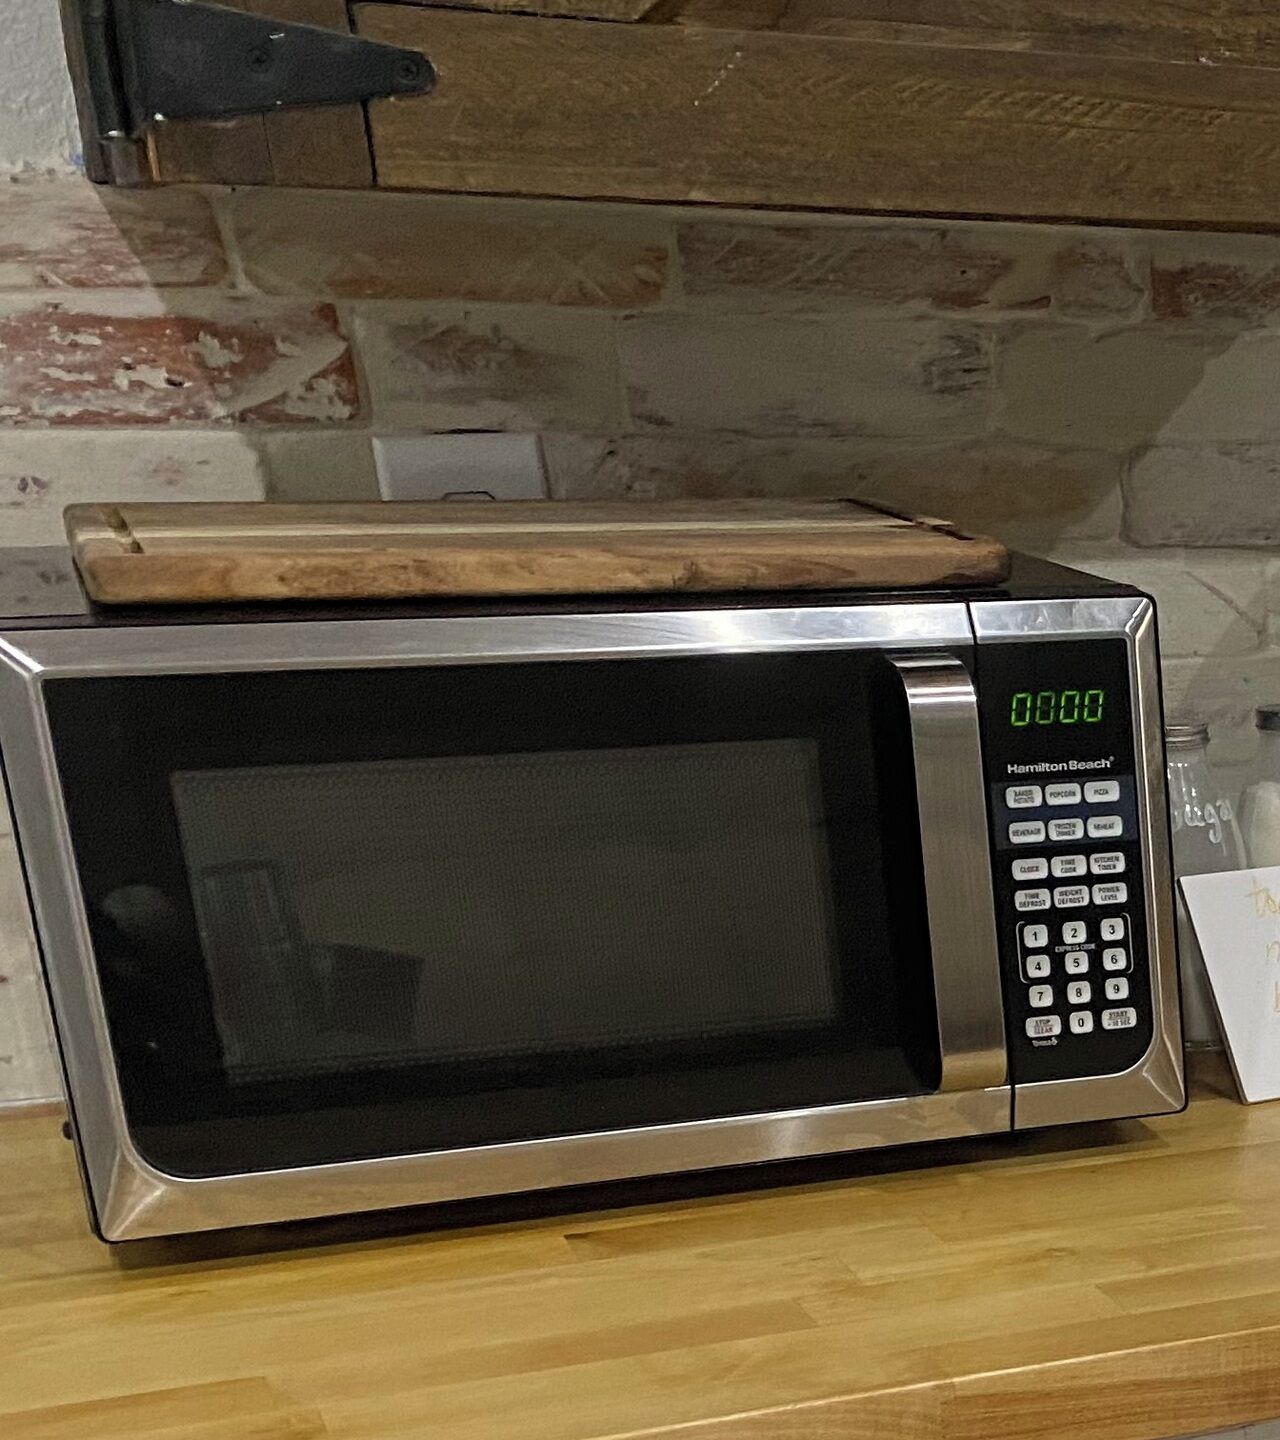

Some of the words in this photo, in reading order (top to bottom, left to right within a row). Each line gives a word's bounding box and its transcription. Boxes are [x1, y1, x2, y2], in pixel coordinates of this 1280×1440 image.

[1007, 762, 1068, 774] Hamilton
[1068, 759, 1111, 771] Beach
[1049, 790, 1076, 798] POPCORN
[1093, 788, 1109, 796] PIZZA
[1070, 928, 1078, 938] 2
[1108, 924, 1116, 935] 3
[1032, 931, 1038, 942] 1
[1072, 958, 1080, 968] 5
[1110, 954, 1118, 965] 6
[1034, 962, 1042, 972] 4
[1075, 987, 1083, 998] 8
[1113, 983, 1120, 994] 9
[1036, 991, 1044, 1002] 7
[1077, 1017, 1085, 1028] 0
